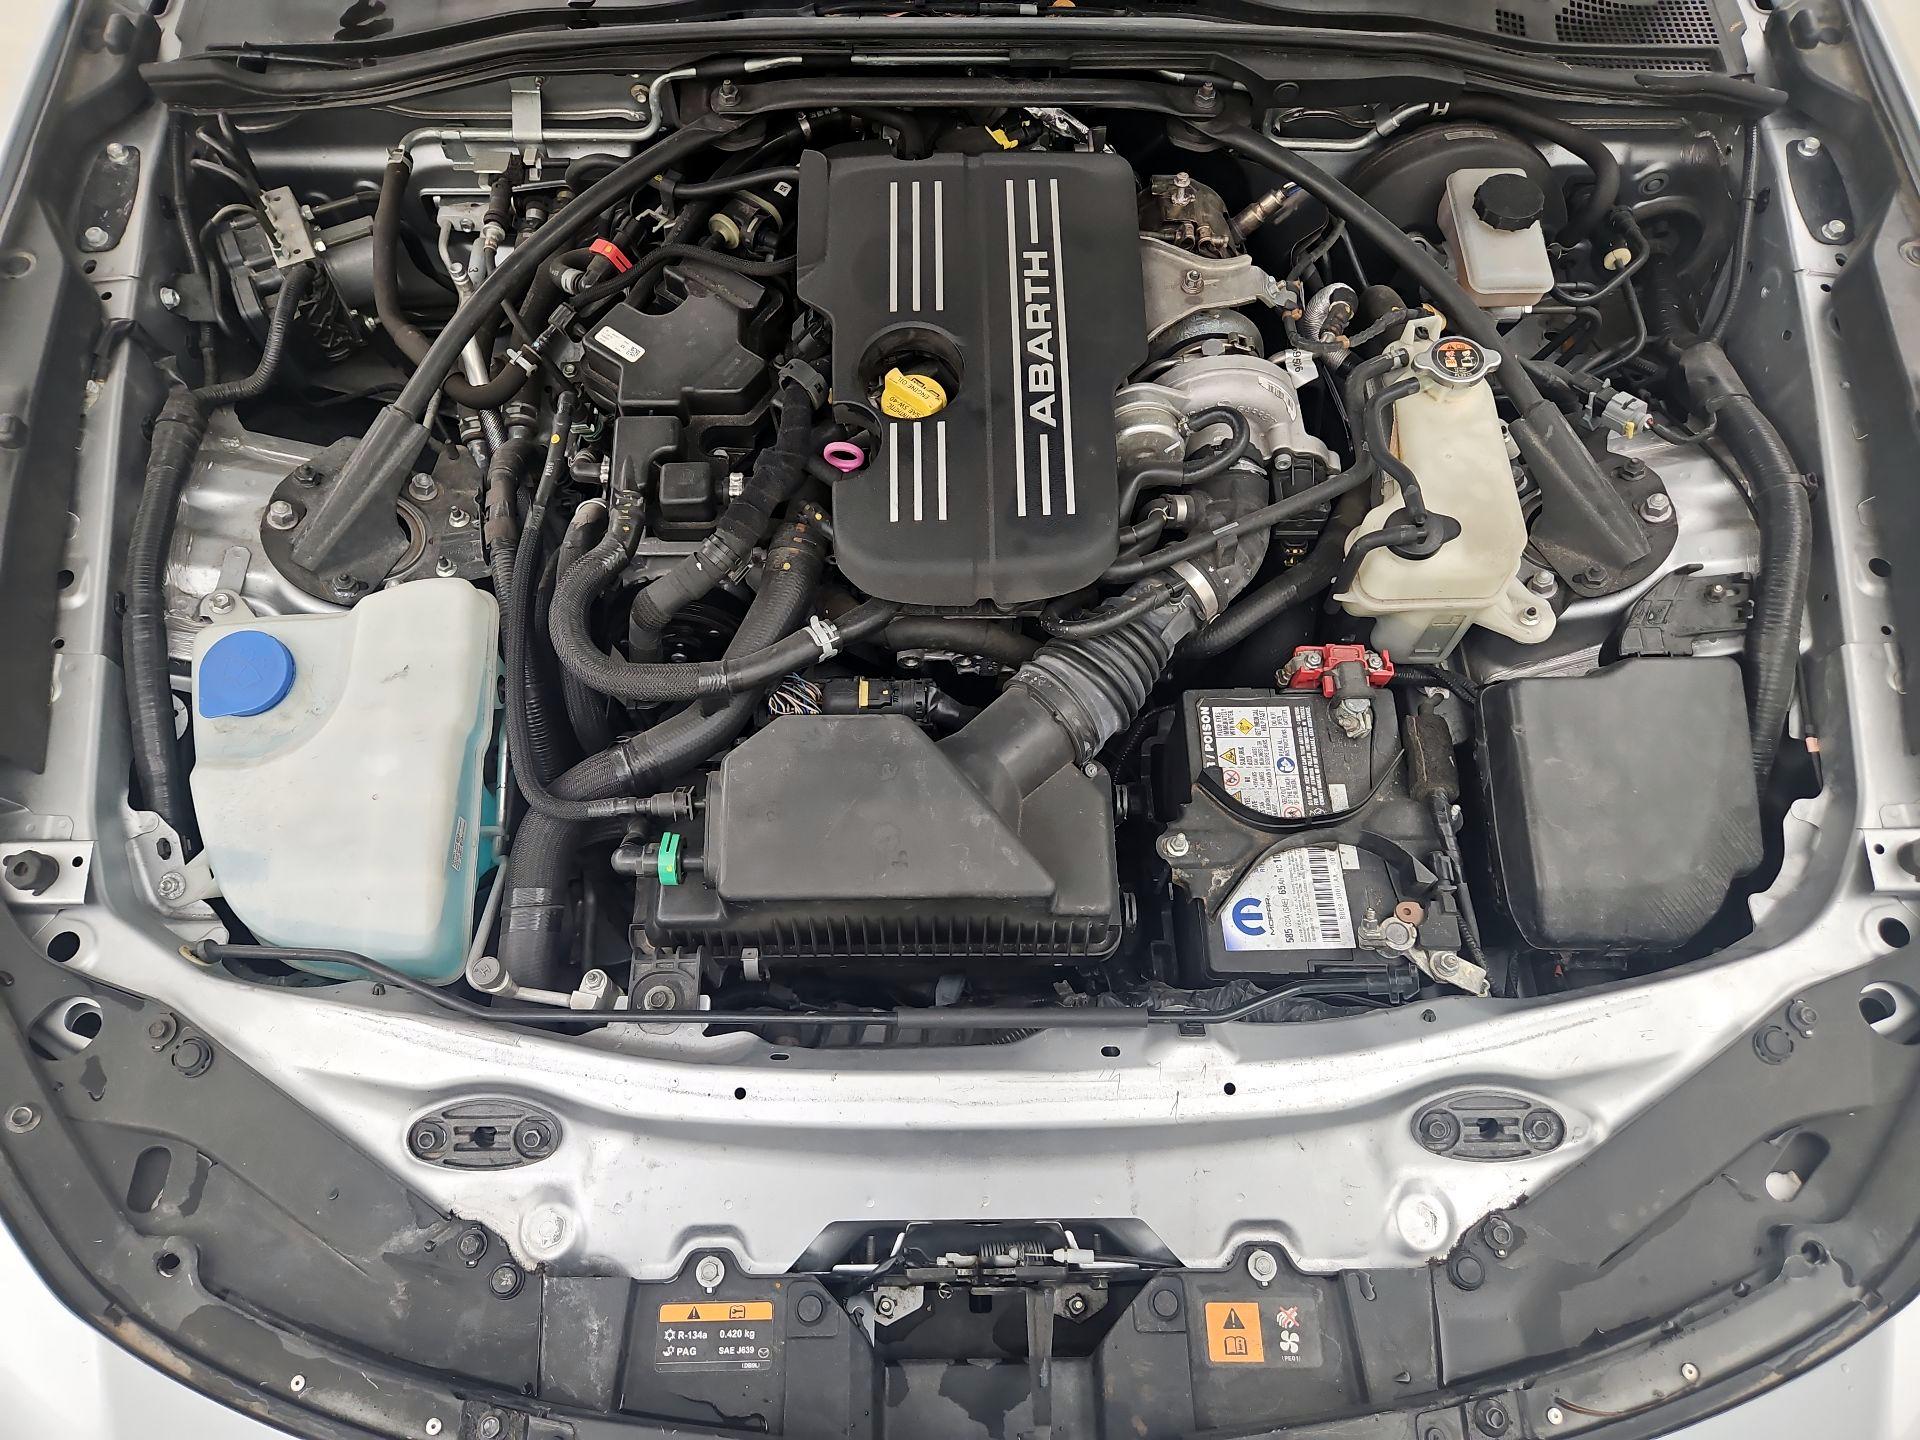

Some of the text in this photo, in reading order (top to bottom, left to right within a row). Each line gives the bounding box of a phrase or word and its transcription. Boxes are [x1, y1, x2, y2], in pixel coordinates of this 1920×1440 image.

[1023, 252, 1056, 427] ABARTH
[897, 377, 930, 400] ENGINE OIL
[889, 396, 920, 418] SAE 5W-40
[1200, 707, 1214, 751] POISON
[1265, 898, 1275, 935] MOPAR
[1284, 929, 1294, 943] 585
[678, 1329, 755, 1339] R-134a 0.420 kg
[677, 1347, 697, 1356] PAG
[737, 1346, 754, 1354] J639
